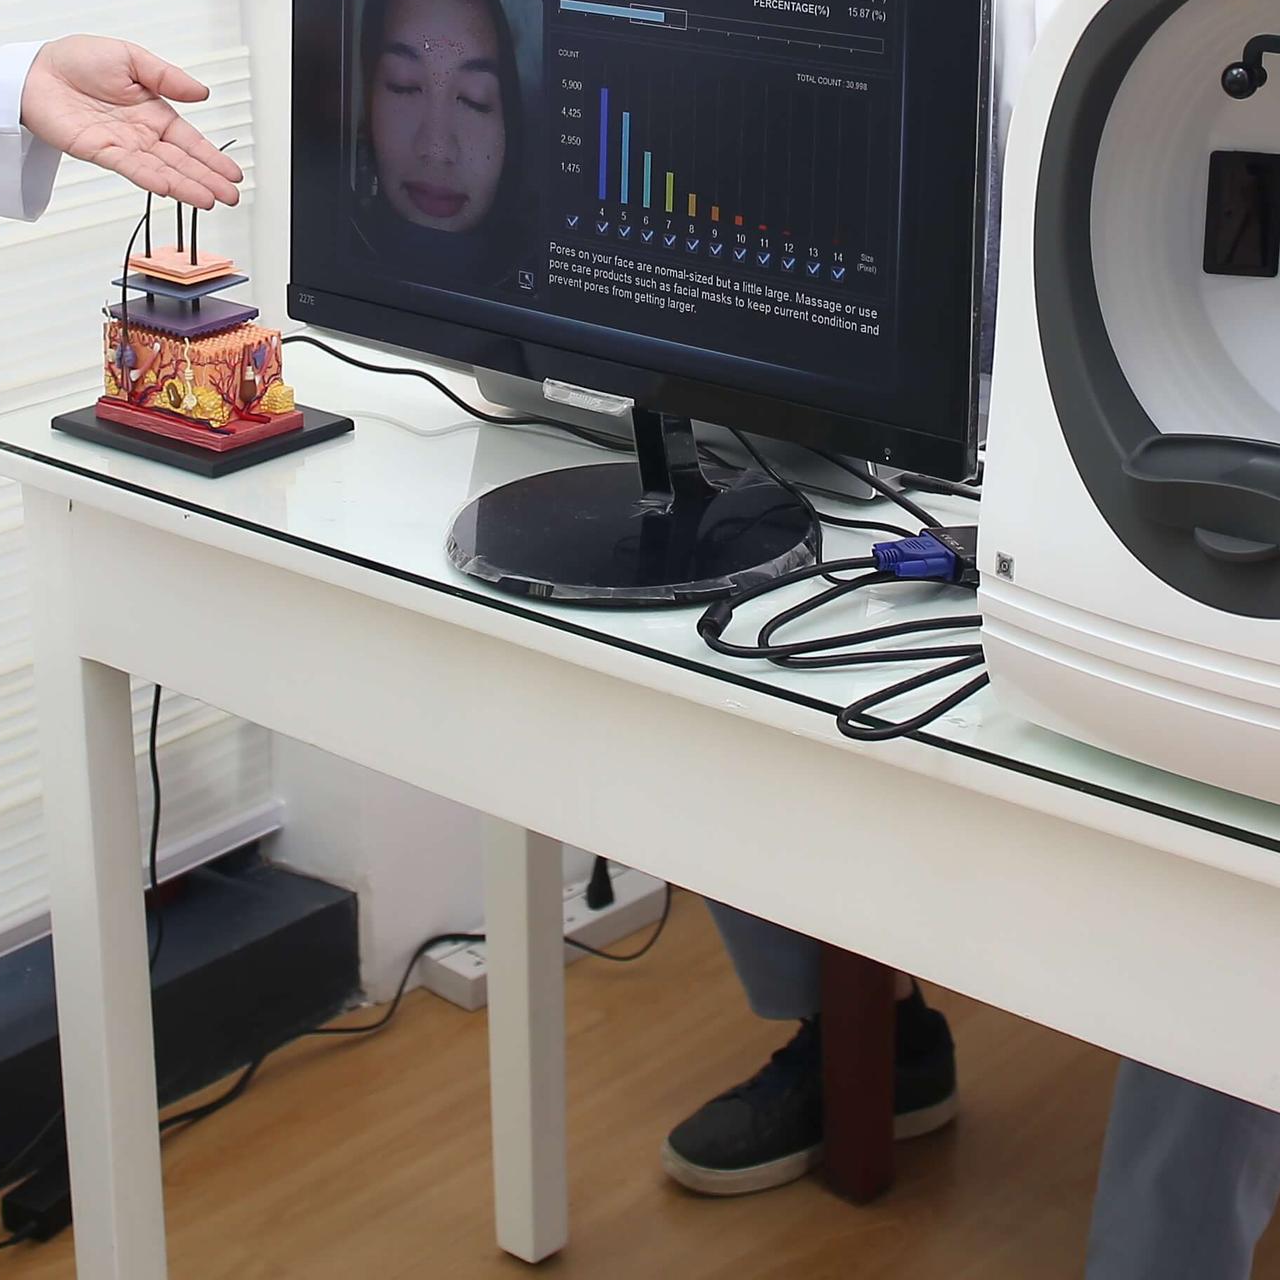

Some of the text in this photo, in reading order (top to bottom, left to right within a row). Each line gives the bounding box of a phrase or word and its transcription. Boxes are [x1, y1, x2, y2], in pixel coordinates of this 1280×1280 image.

[558, 48, 579, 58] COUNT
[562, 79, 582, 91] 5,900
[797, 73, 816, 84] TOTAL
[817, 76, 841, 87] COUNT
[600, 207, 843, 262] 4 5 6 7 8 9 10 11 12 13 14
[549, 242, 878, 319] Pores on your face are normal-sized but a little large. Massage or use
[549, 273, 697, 314] prevent pores from getting larger.
[549, 259, 880, 336] pore care products such as facial masks to keep current condition and
